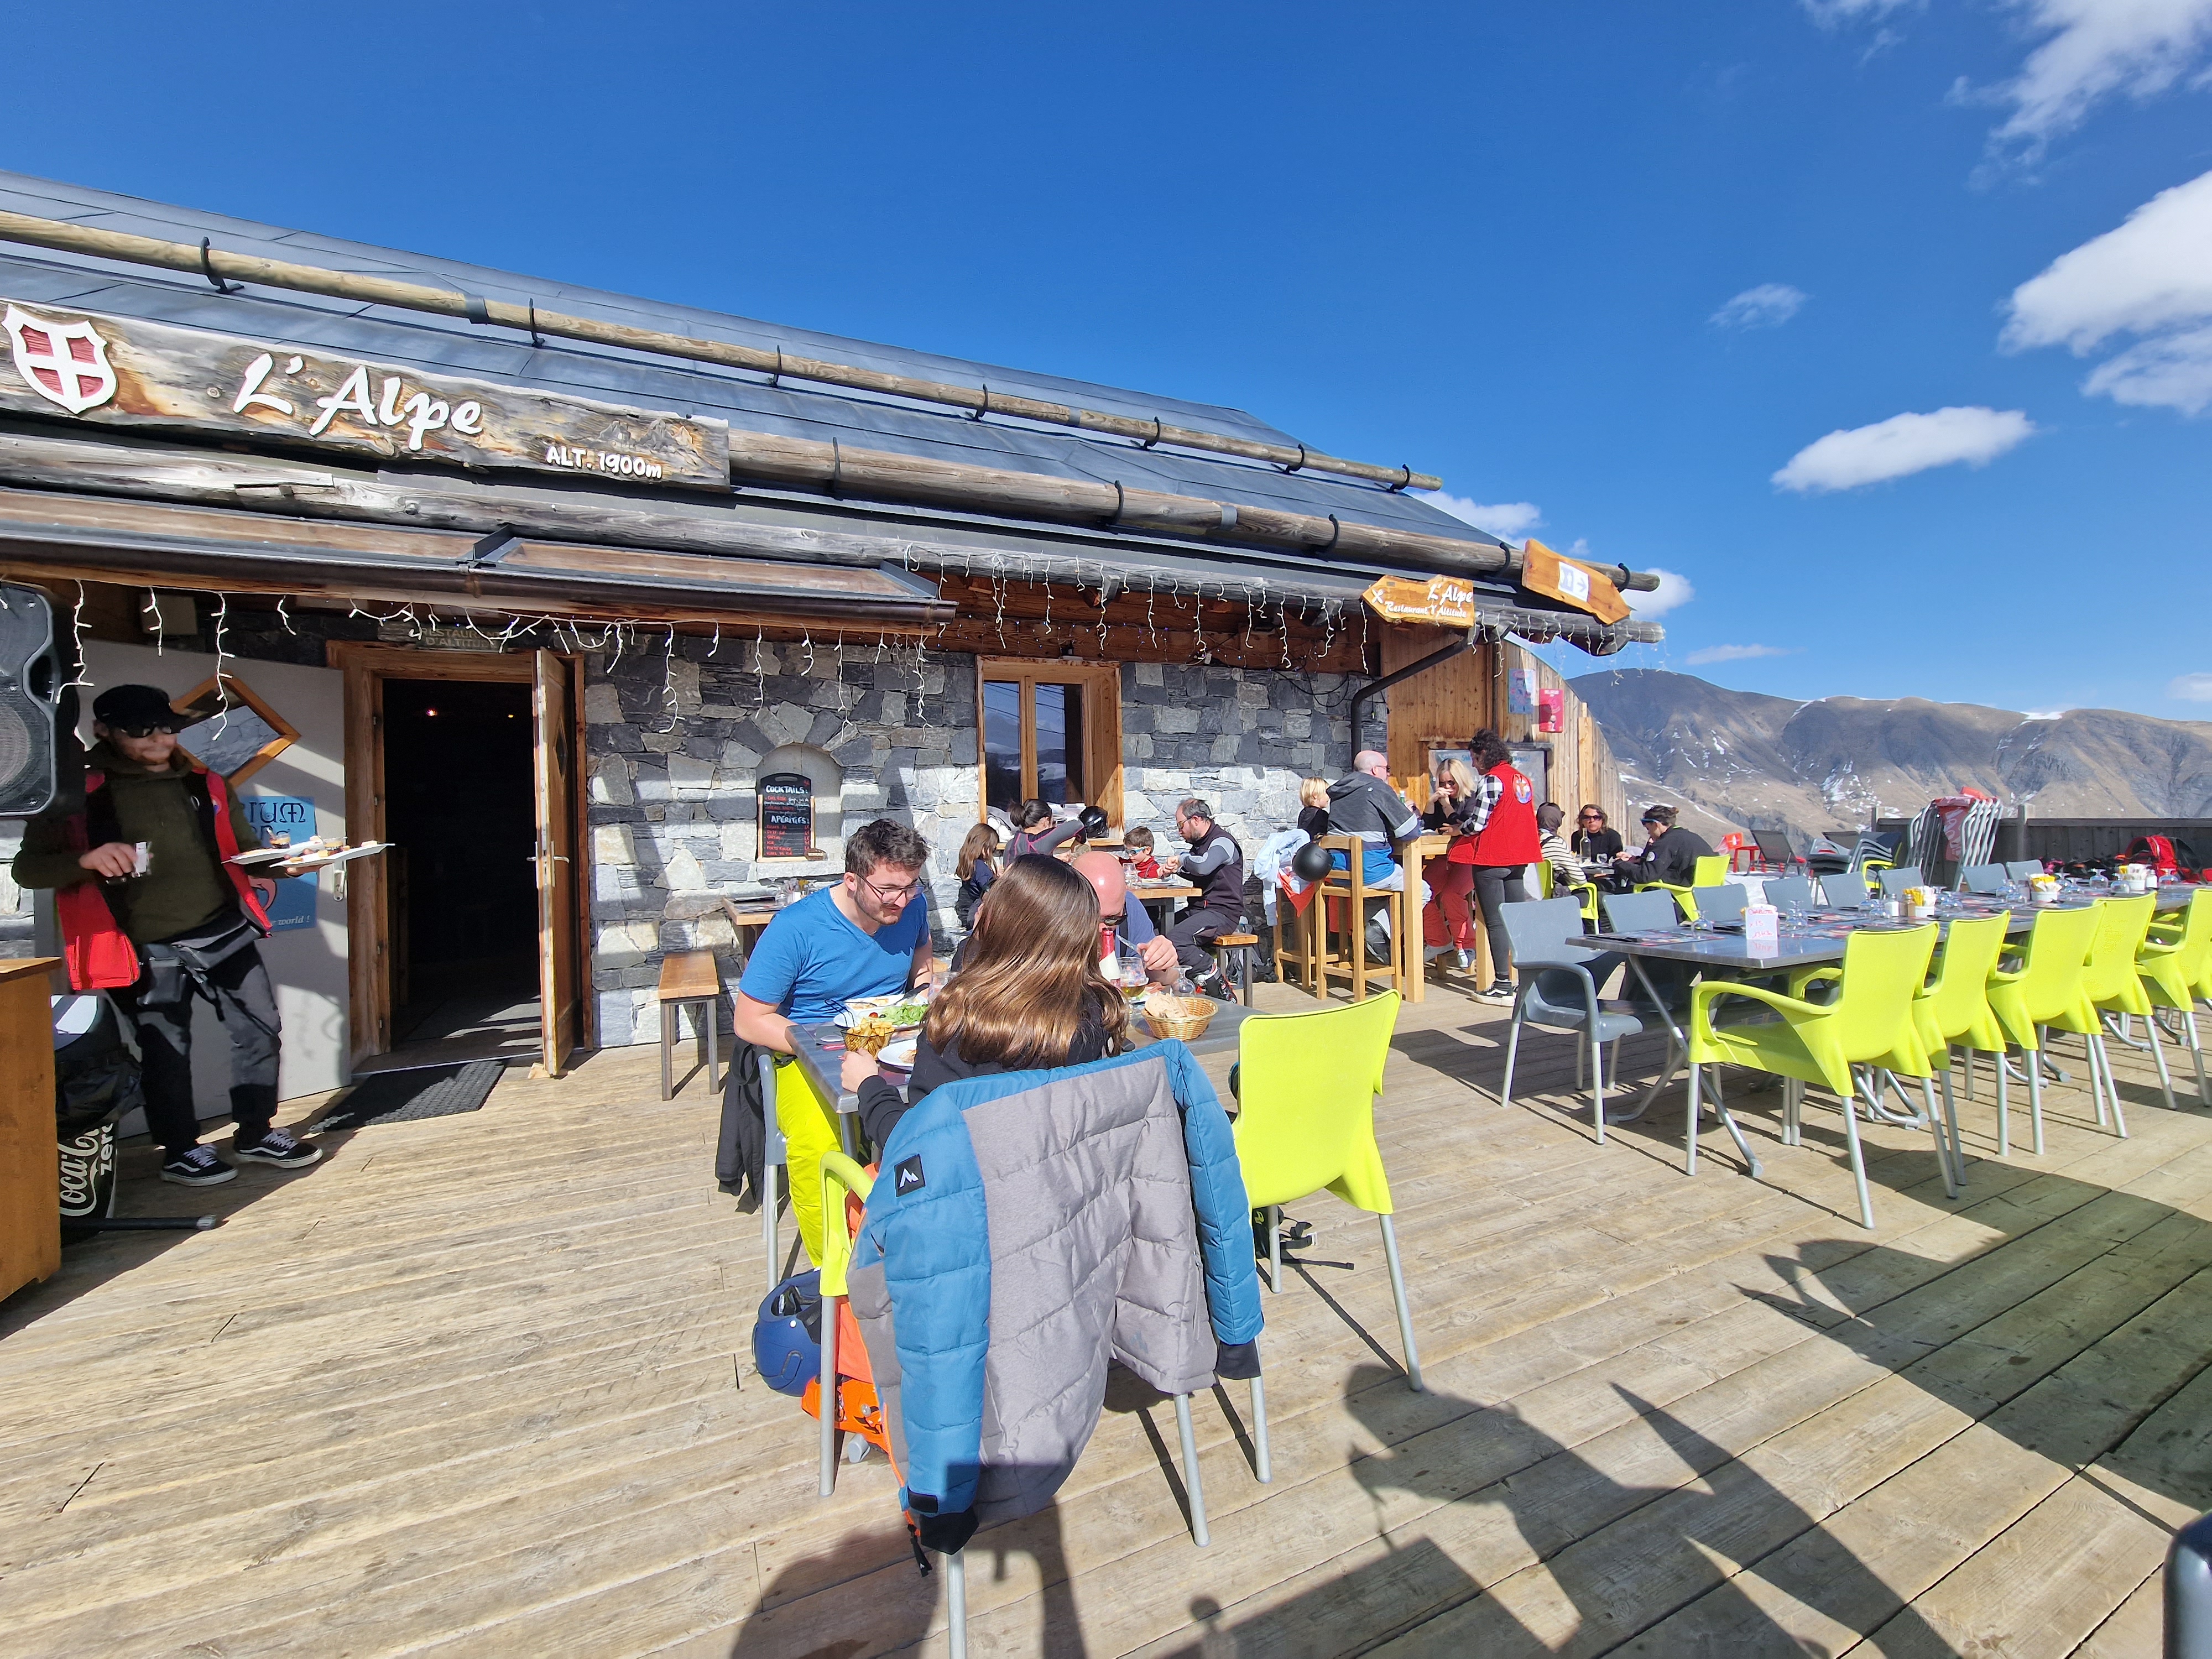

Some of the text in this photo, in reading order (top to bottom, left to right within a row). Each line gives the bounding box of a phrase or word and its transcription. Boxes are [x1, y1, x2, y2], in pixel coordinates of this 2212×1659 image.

[233, 353, 483, 451] L'Alpe
[546, 446, 662, 479] ALT. 1900m
[1427, 583, 1473, 608] L'Alpe
[1384, 601, 1428, 615] Restaurant
[421, 628, 500, 638] RESTAURNT
[249, 802, 306, 823] IUM
